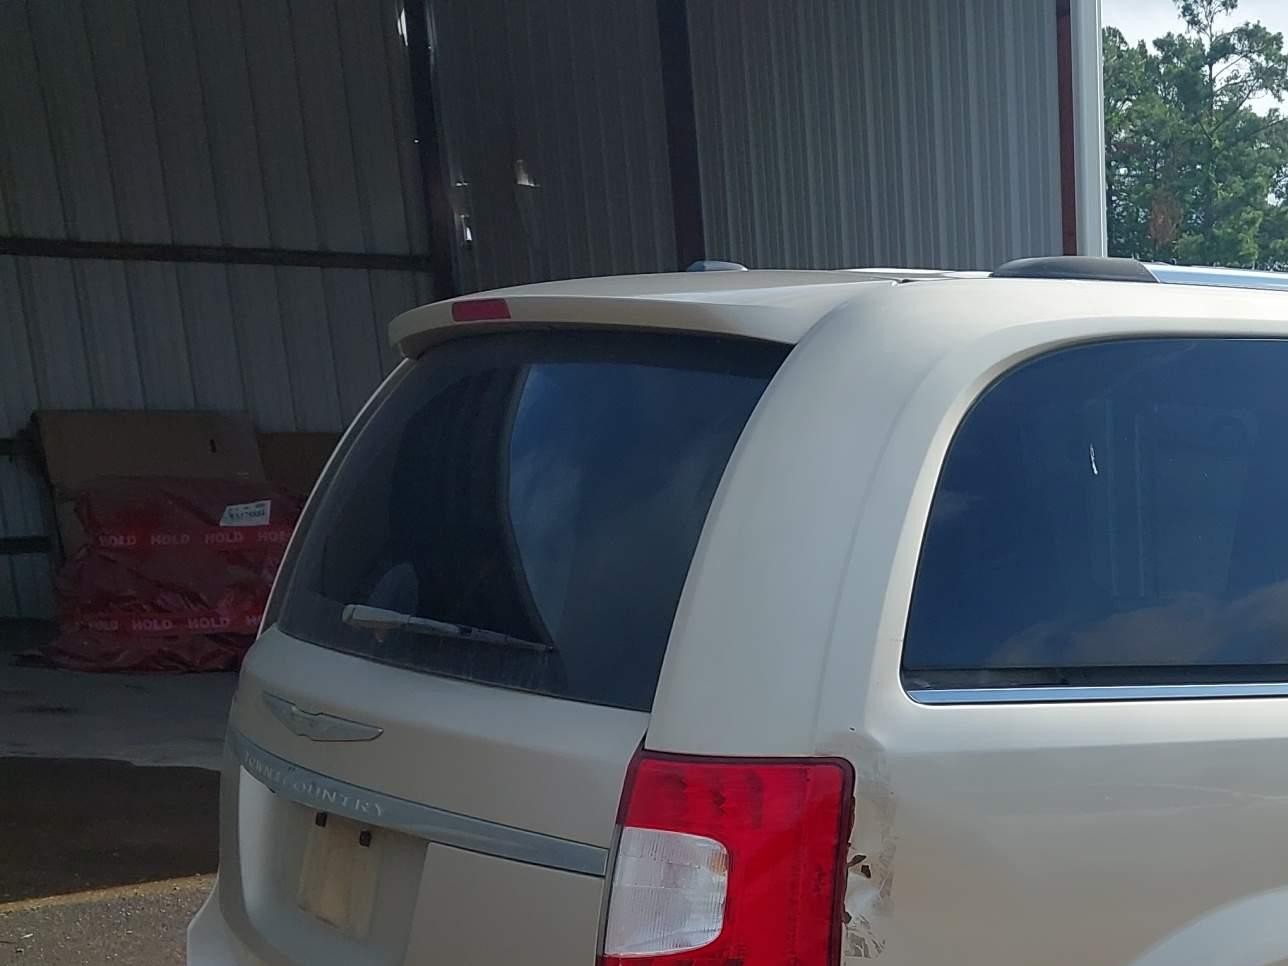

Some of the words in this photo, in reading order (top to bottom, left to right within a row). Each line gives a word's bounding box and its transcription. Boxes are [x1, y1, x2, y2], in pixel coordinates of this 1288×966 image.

[150, 533, 190, 546] HOLD
[206, 531, 245, 545] HOLD
[132, 618, 174, 630] HOLD
[188, 616, 231, 629] HOLD
